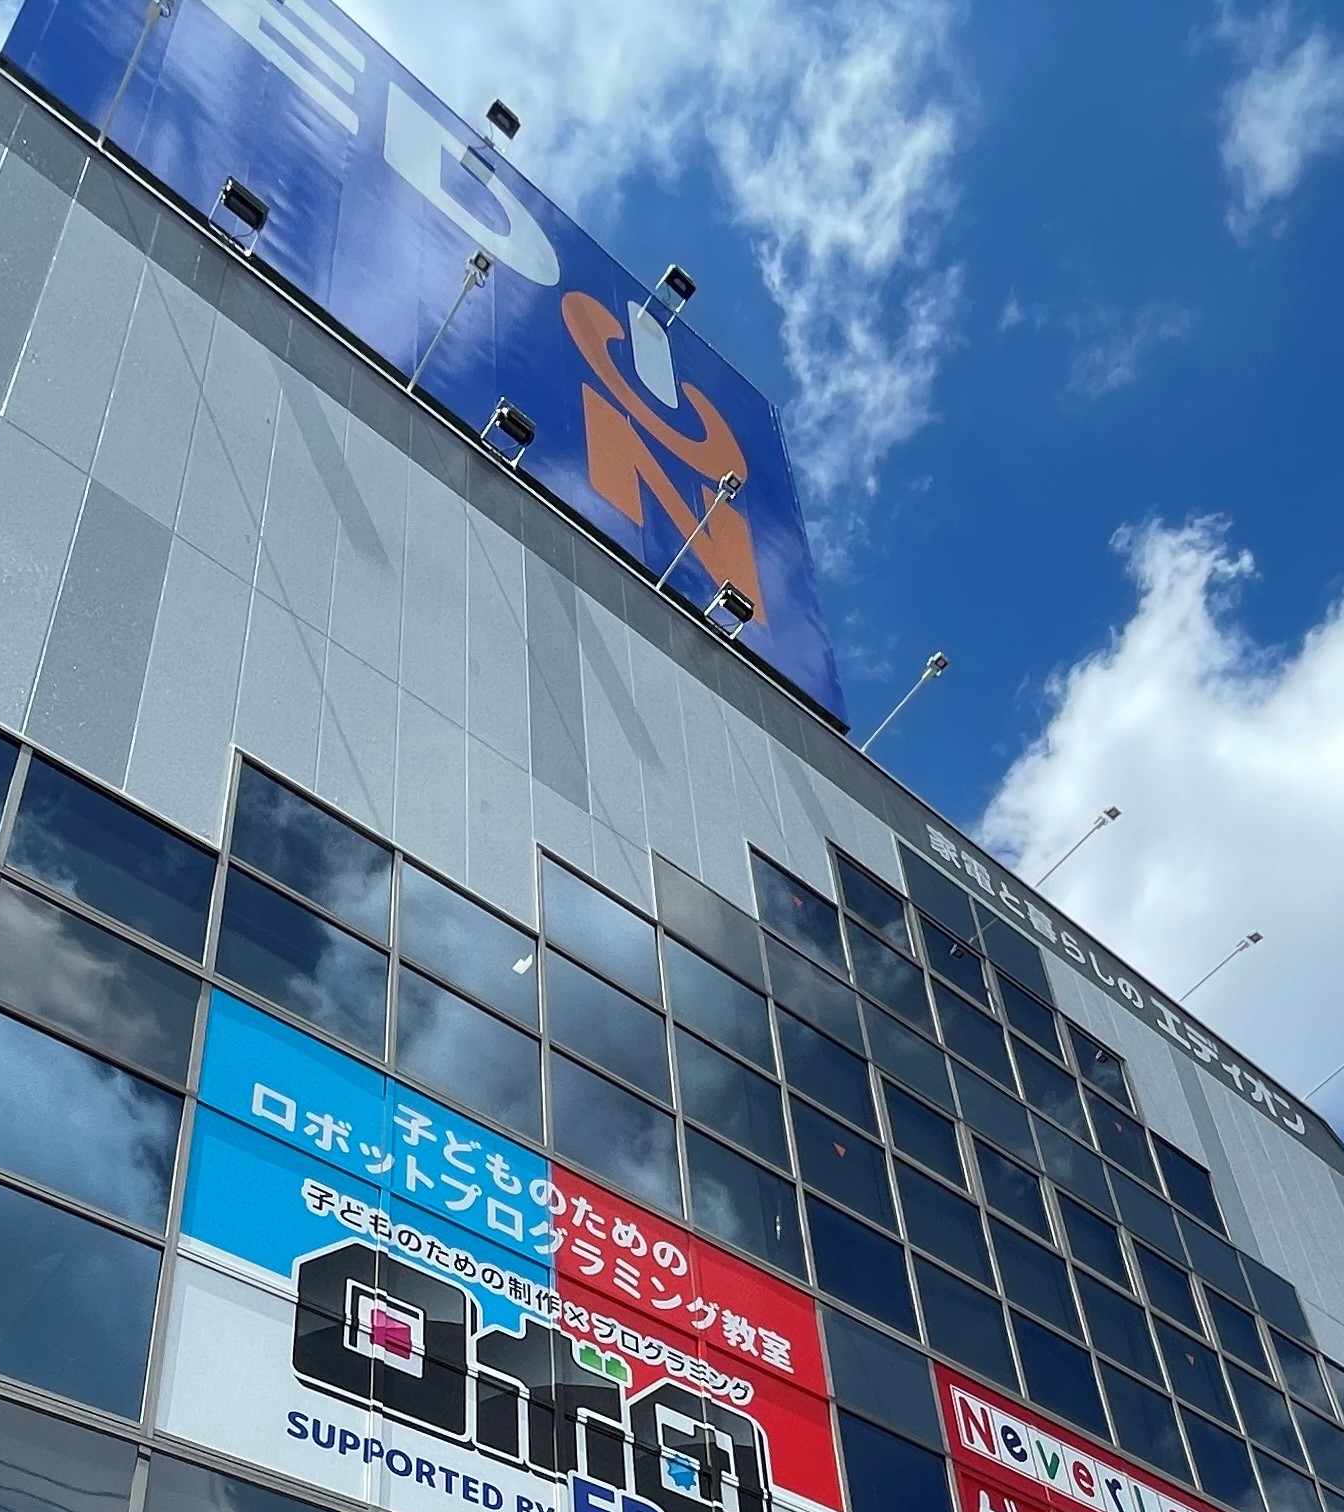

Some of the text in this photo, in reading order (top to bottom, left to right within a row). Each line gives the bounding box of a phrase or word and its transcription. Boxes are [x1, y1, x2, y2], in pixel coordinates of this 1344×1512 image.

[252, 1082, 796, 1376] ロボットプログラミング教室
[394, 1102, 688, 1276] 子どものための
[287, 1410, 504, 1510] SUPPORTED
